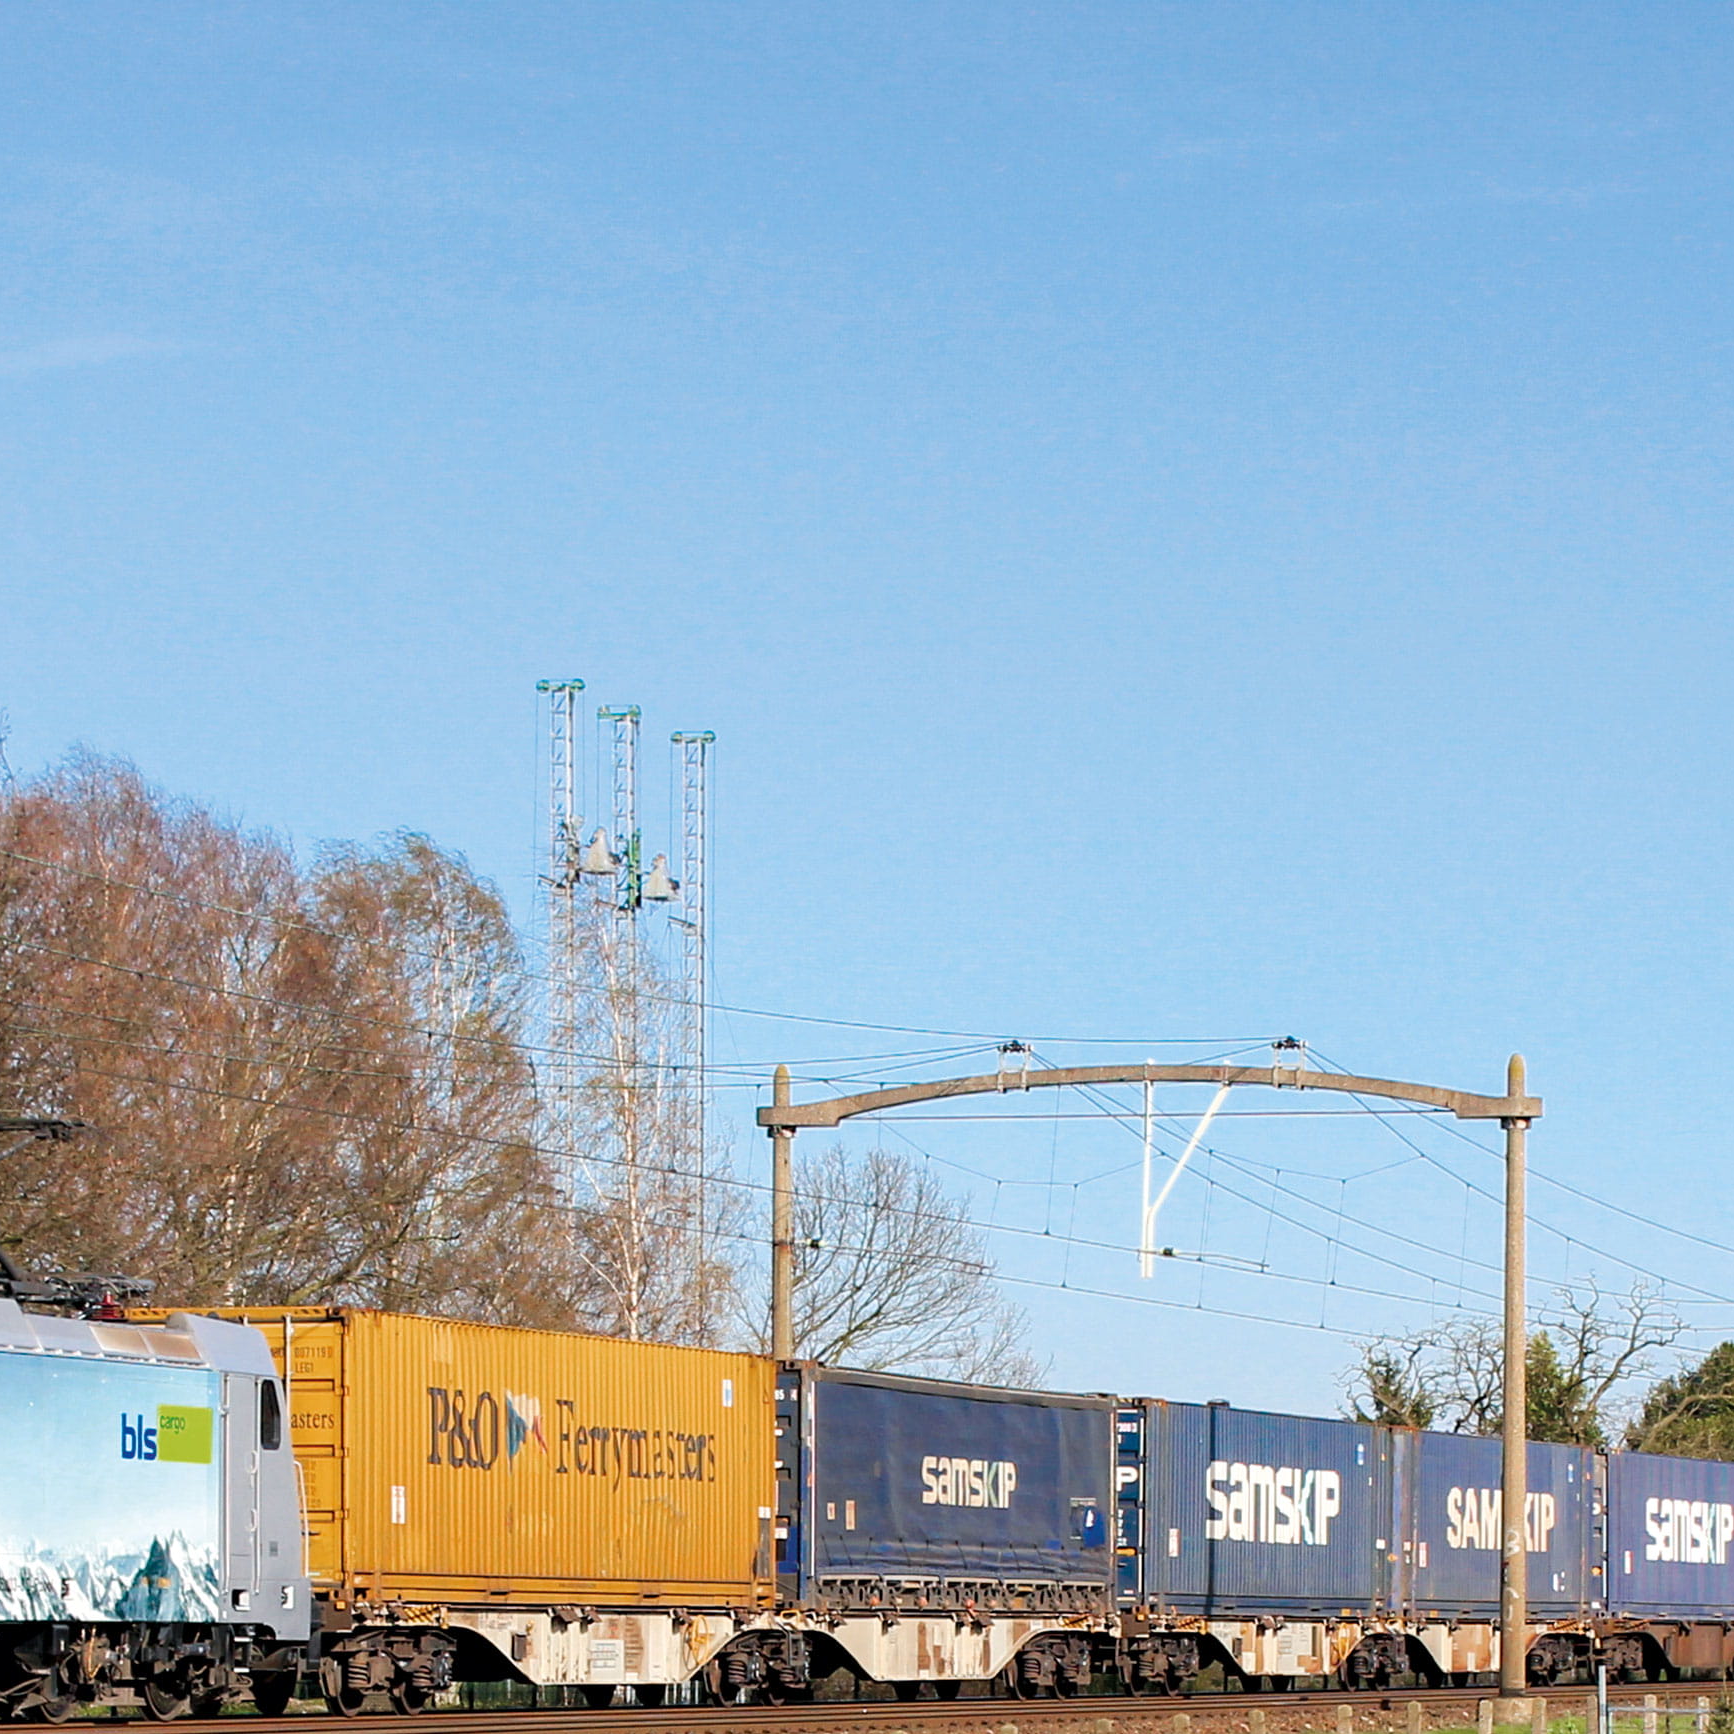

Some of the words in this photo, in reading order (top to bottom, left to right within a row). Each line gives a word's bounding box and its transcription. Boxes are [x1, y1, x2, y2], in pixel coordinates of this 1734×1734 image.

[120, 1412, 157, 1461] bls
[159, 1415, 186, 1435] cargo
[427, 1386, 499, 1471] P&O
[555, 1399, 716, 1494] Ferrymasters
[1446, 1486, 1556, 1553] SAMKIP
